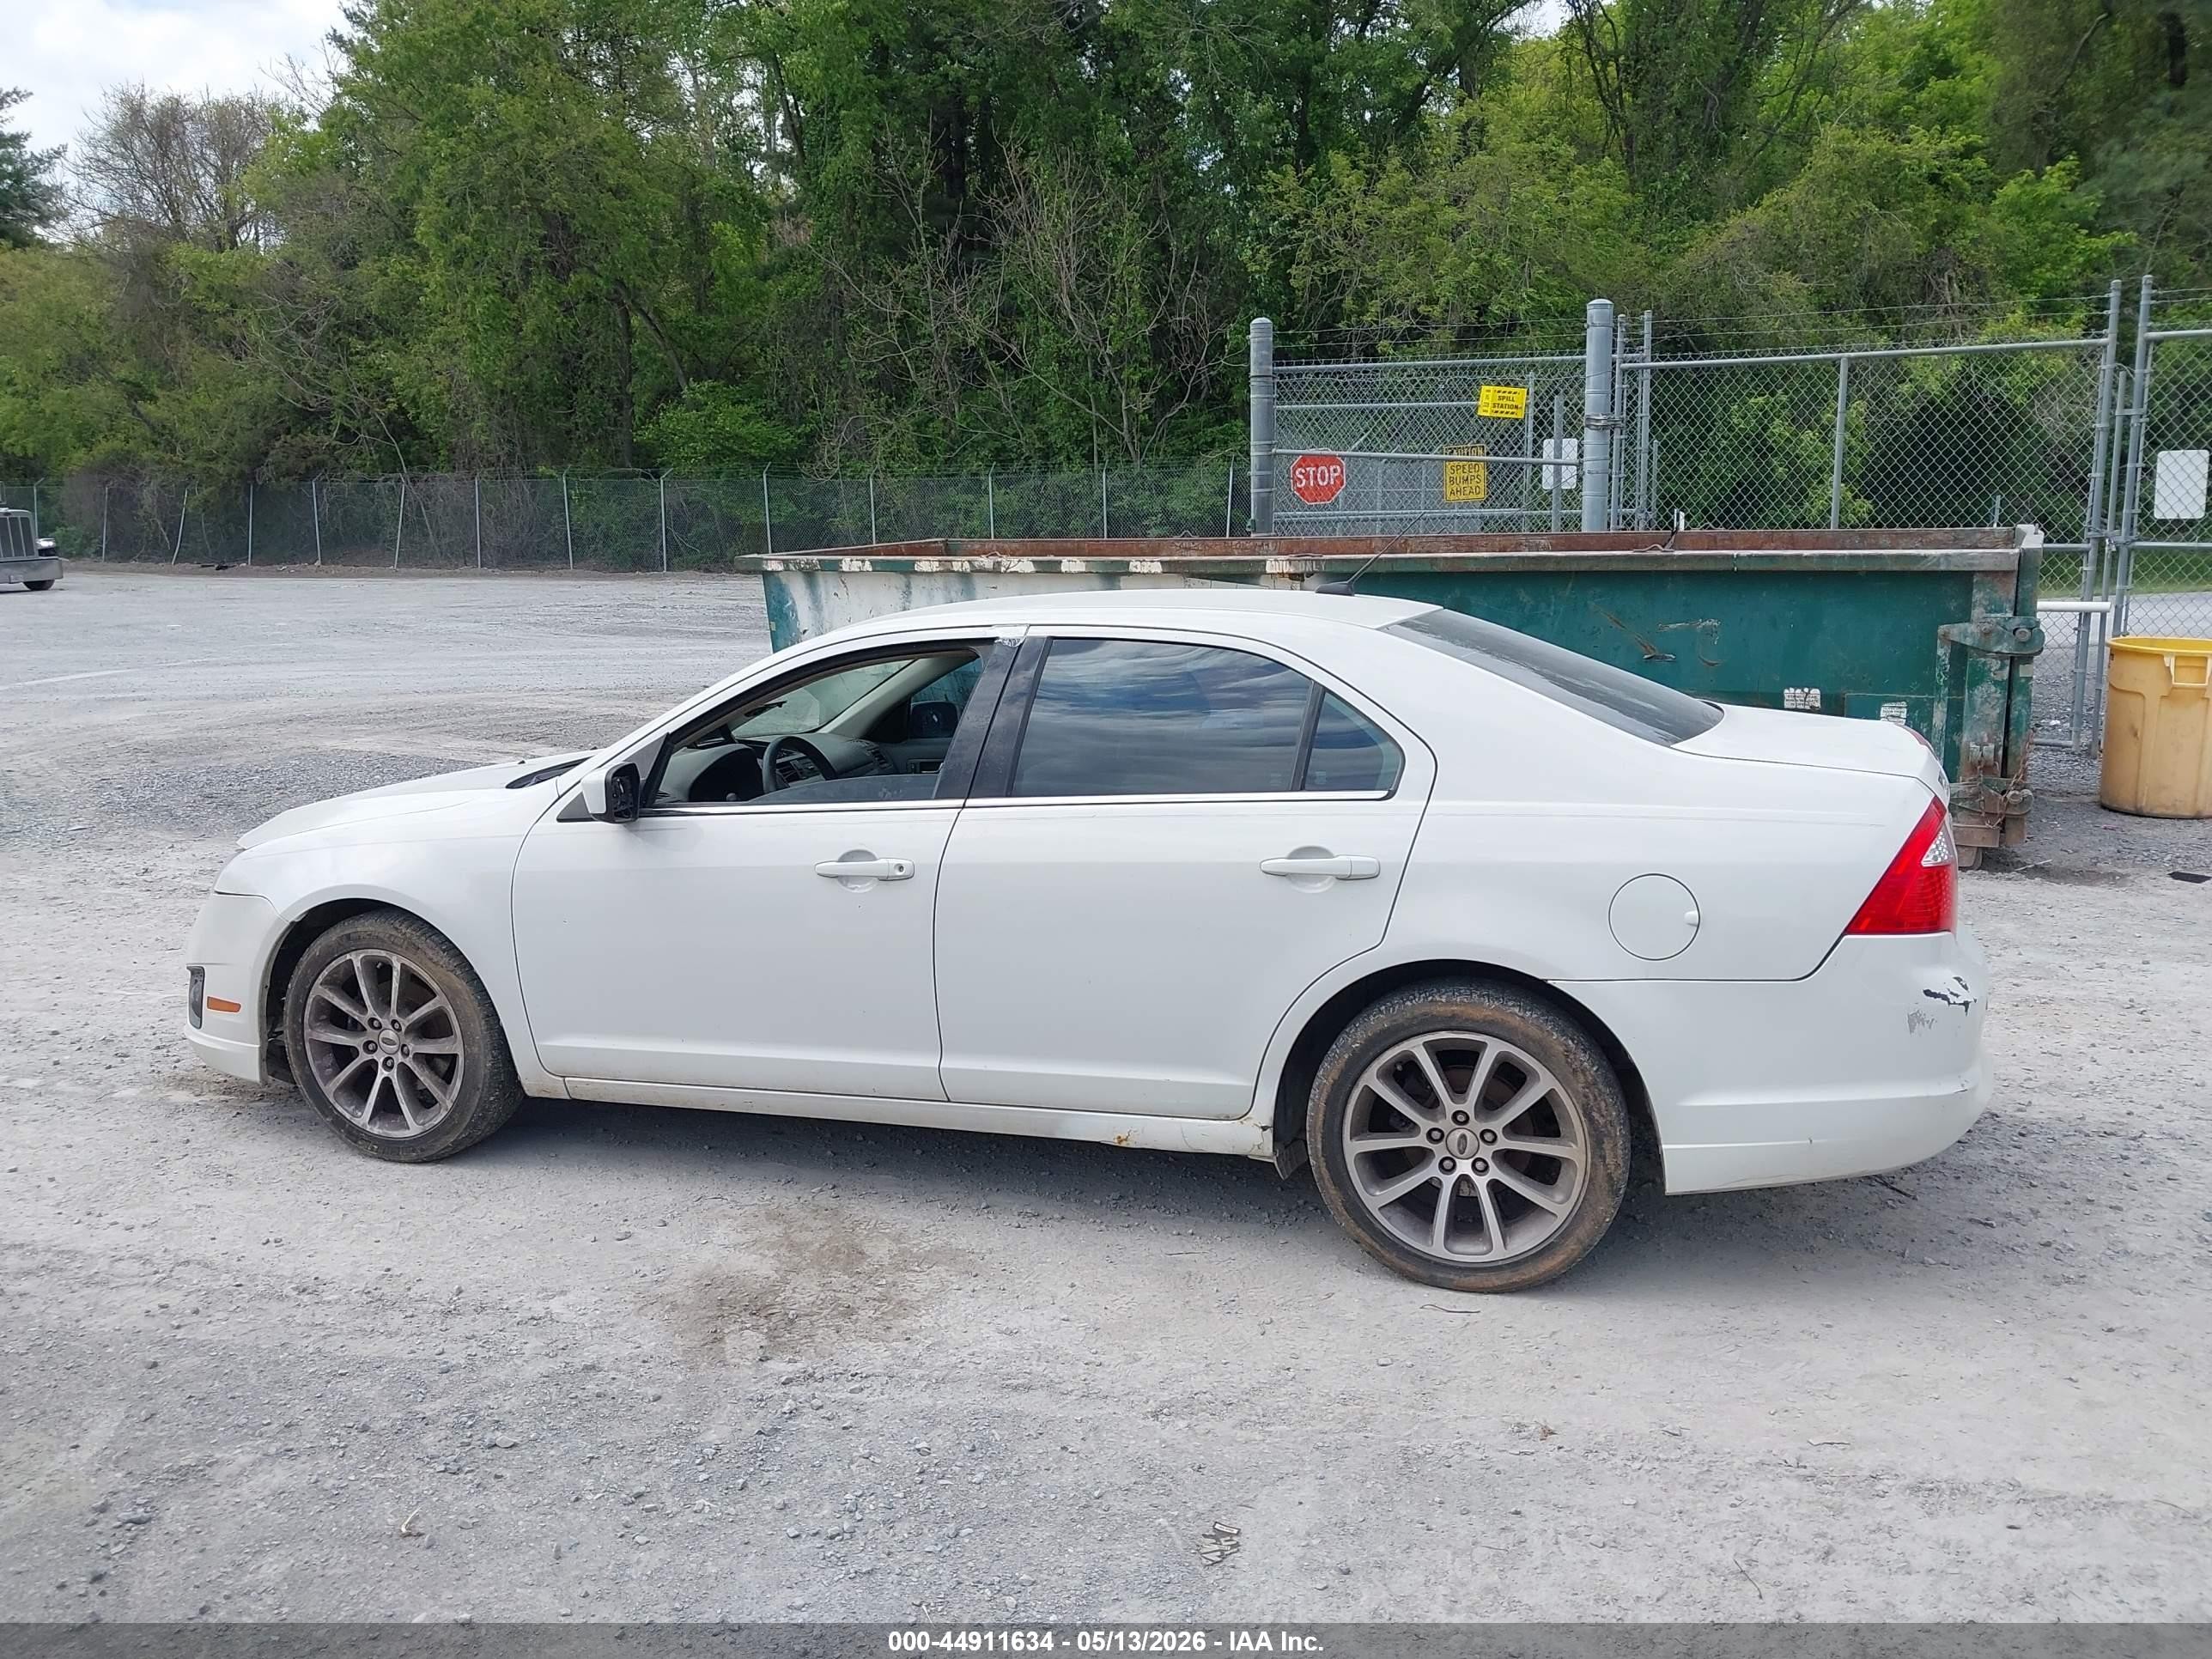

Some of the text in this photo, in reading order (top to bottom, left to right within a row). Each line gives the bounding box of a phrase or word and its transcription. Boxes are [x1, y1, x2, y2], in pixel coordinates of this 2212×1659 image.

[1449, 464, 1480, 475] SPEED
[1295, 465, 1341, 488] STOP
[1449, 475, 1481, 486] BUMPS
[1449, 486, 1480, 496] AHEAD
